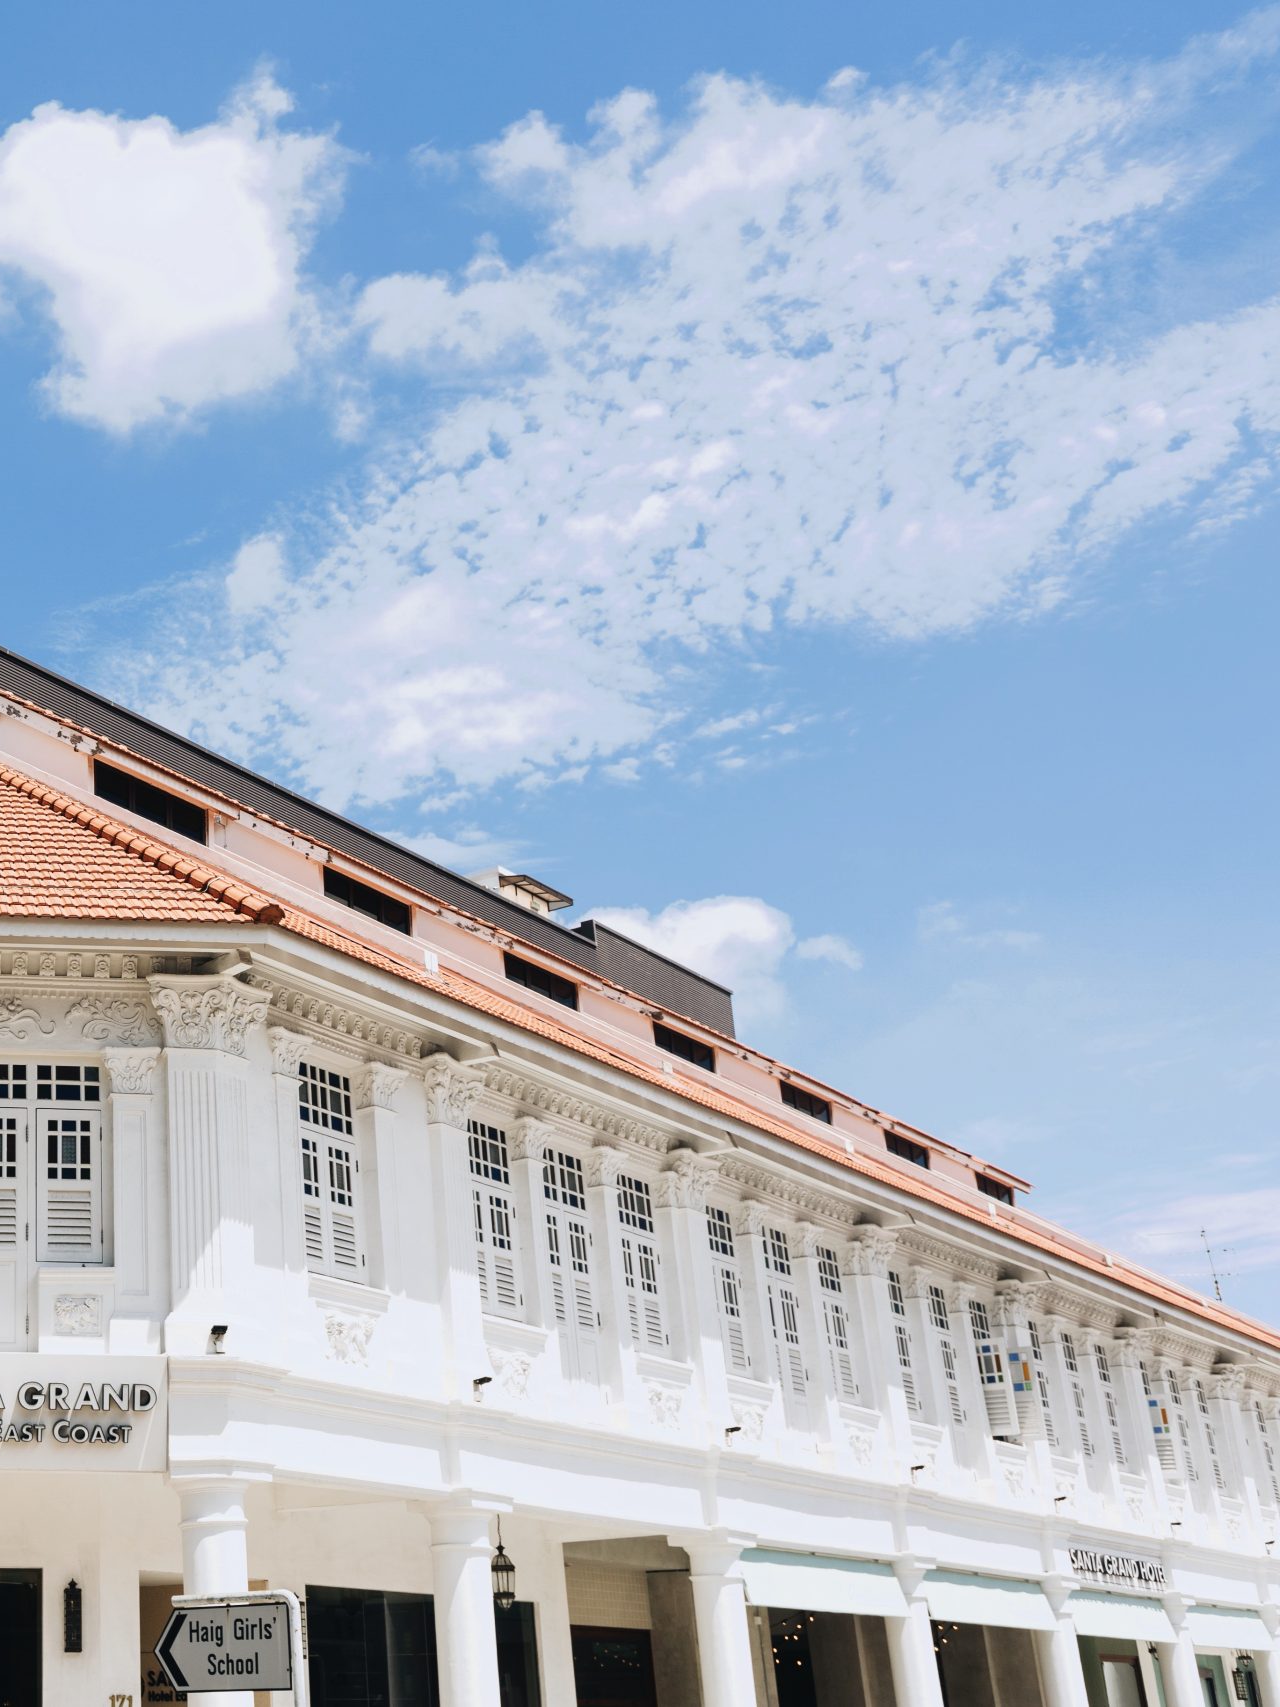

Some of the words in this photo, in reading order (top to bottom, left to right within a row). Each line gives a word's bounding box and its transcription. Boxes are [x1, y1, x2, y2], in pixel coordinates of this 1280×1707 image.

[19, 1382, 157, 1412] GRAND
[1069, 1548, 1104, 1573] SANTA
[1104, 1554, 1140, 1579] GRAND
[1140, 1560, 1167, 1583] HOTEL
[189, 1620, 223, 1647] Haig
[233, 1616, 276, 1640] Girls'
[207, 1652, 259, 1675] School
